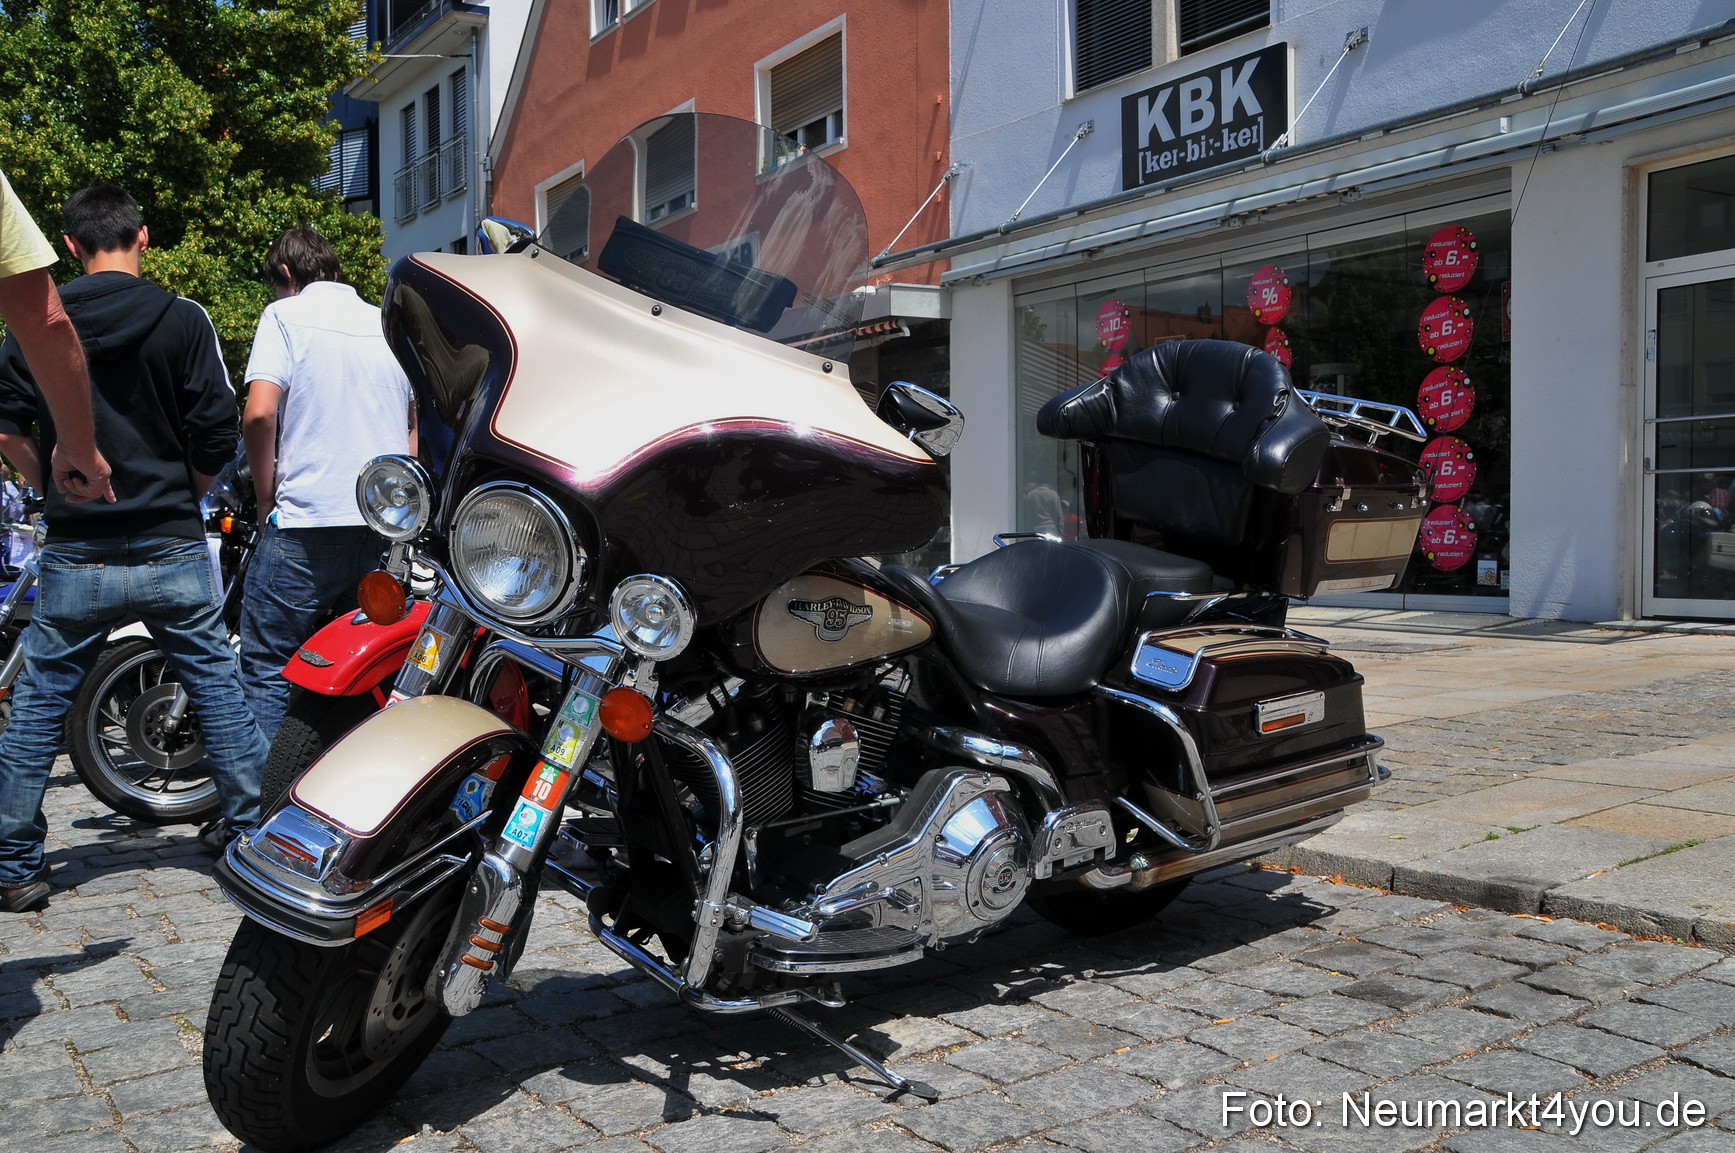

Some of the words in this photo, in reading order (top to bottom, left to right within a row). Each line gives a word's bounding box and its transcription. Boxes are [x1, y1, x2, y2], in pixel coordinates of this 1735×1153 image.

[1138, 56, 1264, 150] KBK
[1433, 258, 1443, 266] ab
[1445, 250, 1469, 266] 6,-
[1438, 271, 1466, 279] reduziert
[1251, 278, 1273, 286] reduziert
[1261, 286, 1279, 306] %
[1262, 305, 1283, 313] reduziert
[1423, 310, 1450, 321] reduziert
[1429, 330, 1440, 339] ab
[1441, 320, 1464, 336] 6,-
[1436, 339, 1463, 350] reduziert
[1422, 380, 1449, 392] reduziert
[1429, 401, 1439, 409] ab
[1437, 408, 1464, 420] reduziert
[1443, 529, 1468, 545] 6,-
[794, 598, 872, 614] HARLEY-DAVIDSON
[825, 608, 848, 628] 95
[412, 652, 428, 664] A06
[550, 744, 566, 756] A09
[532, 780, 552, 800] 10
[511, 828, 528, 840] A07
